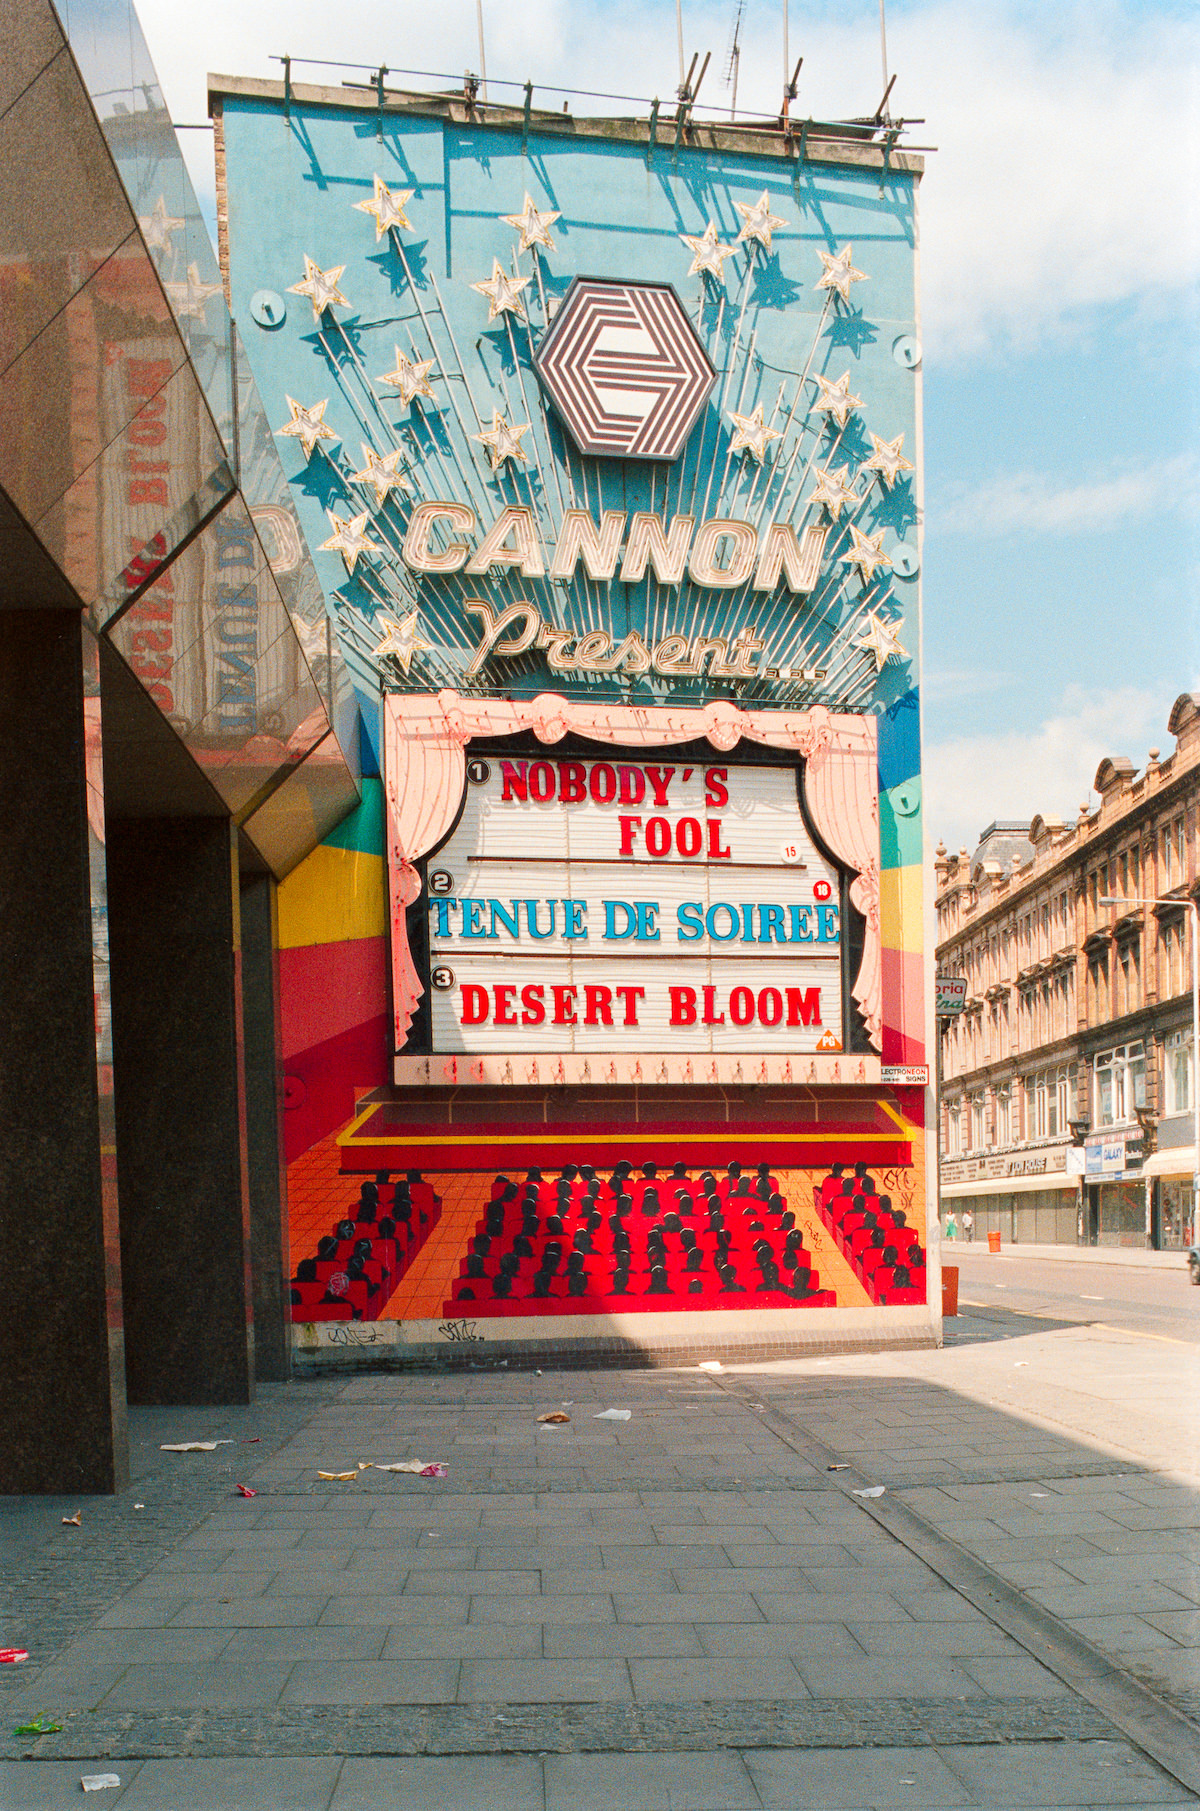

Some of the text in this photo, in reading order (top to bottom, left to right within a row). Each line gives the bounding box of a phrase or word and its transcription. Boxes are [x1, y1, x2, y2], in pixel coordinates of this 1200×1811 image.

[404, 500, 829, 593] CANNON
[471, 763, 482, 780] 1
[499, 760, 729, 808] NOBODY'S
[618, 815, 731, 858] FOOL
[785, 846, 796, 858] 15
[434, 874, 449, 891] 2
[816, 884, 828, 896] 18
[429, 896, 840, 943] TENUE DE SOIREE
[435, 970, 450, 987] 3
[459, 984, 823, 1027] DESERT BLOOM
[822, 1036, 835, 1047] PG
